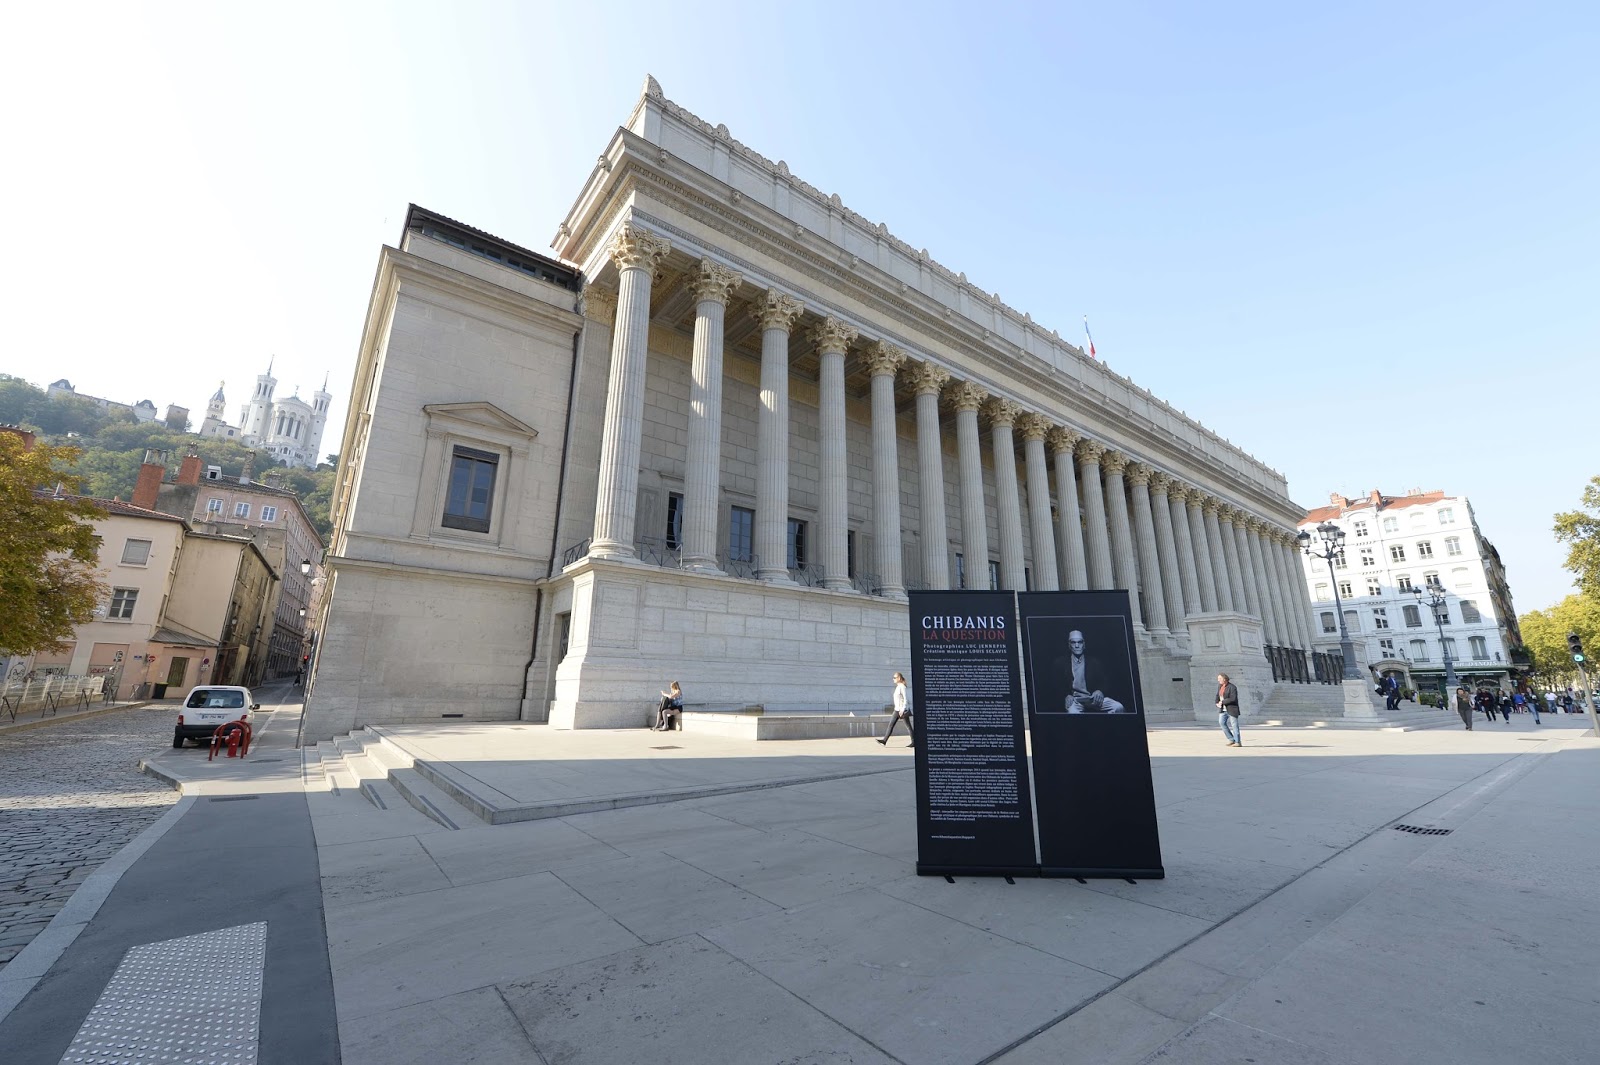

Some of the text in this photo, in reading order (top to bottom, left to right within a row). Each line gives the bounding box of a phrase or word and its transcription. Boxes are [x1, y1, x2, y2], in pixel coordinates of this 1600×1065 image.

[922, 616, 1005, 629] CHIBANIS
[923, 629, 1006, 642] LA QUESTION
